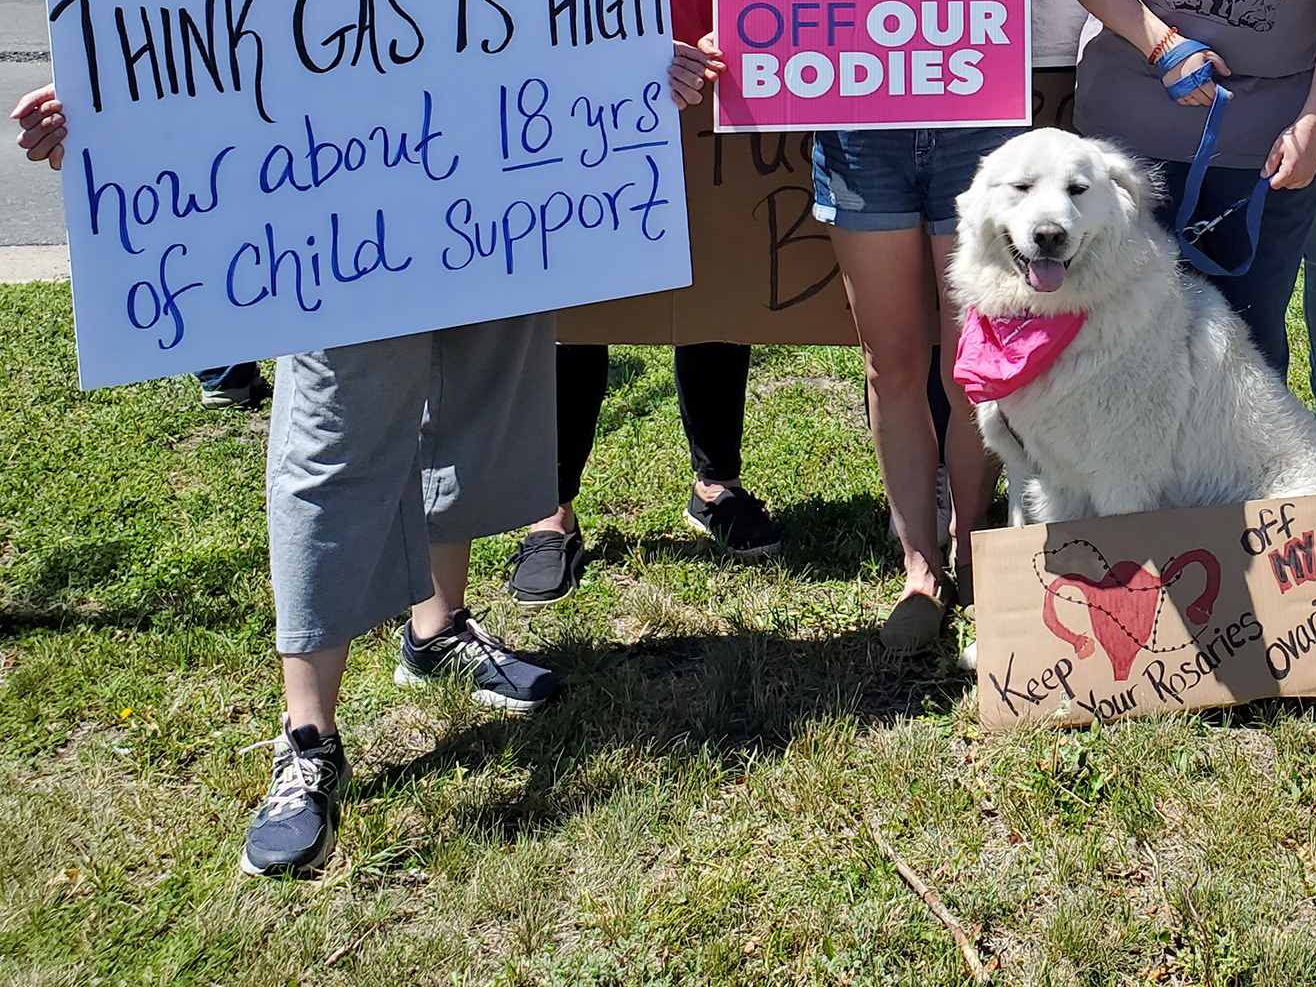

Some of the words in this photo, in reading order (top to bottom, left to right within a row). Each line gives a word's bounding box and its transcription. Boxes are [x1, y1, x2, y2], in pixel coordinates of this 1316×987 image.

[737, 2, 855, 48] OFF
[866, 0, 1011, 47] OUR
[742, 48, 985, 99] BODIES
[83, 145, 235, 255] how
[260, 90, 460, 195] about
[499, 79, 551, 162] 18
[570, 81, 664, 168] yrs
[127, 243, 203, 350] of
[989, 652, 1076, 718] Keep
[1077, 682, 1139, 720] Your
[1142, 611, 1263, 705] Rosaries
